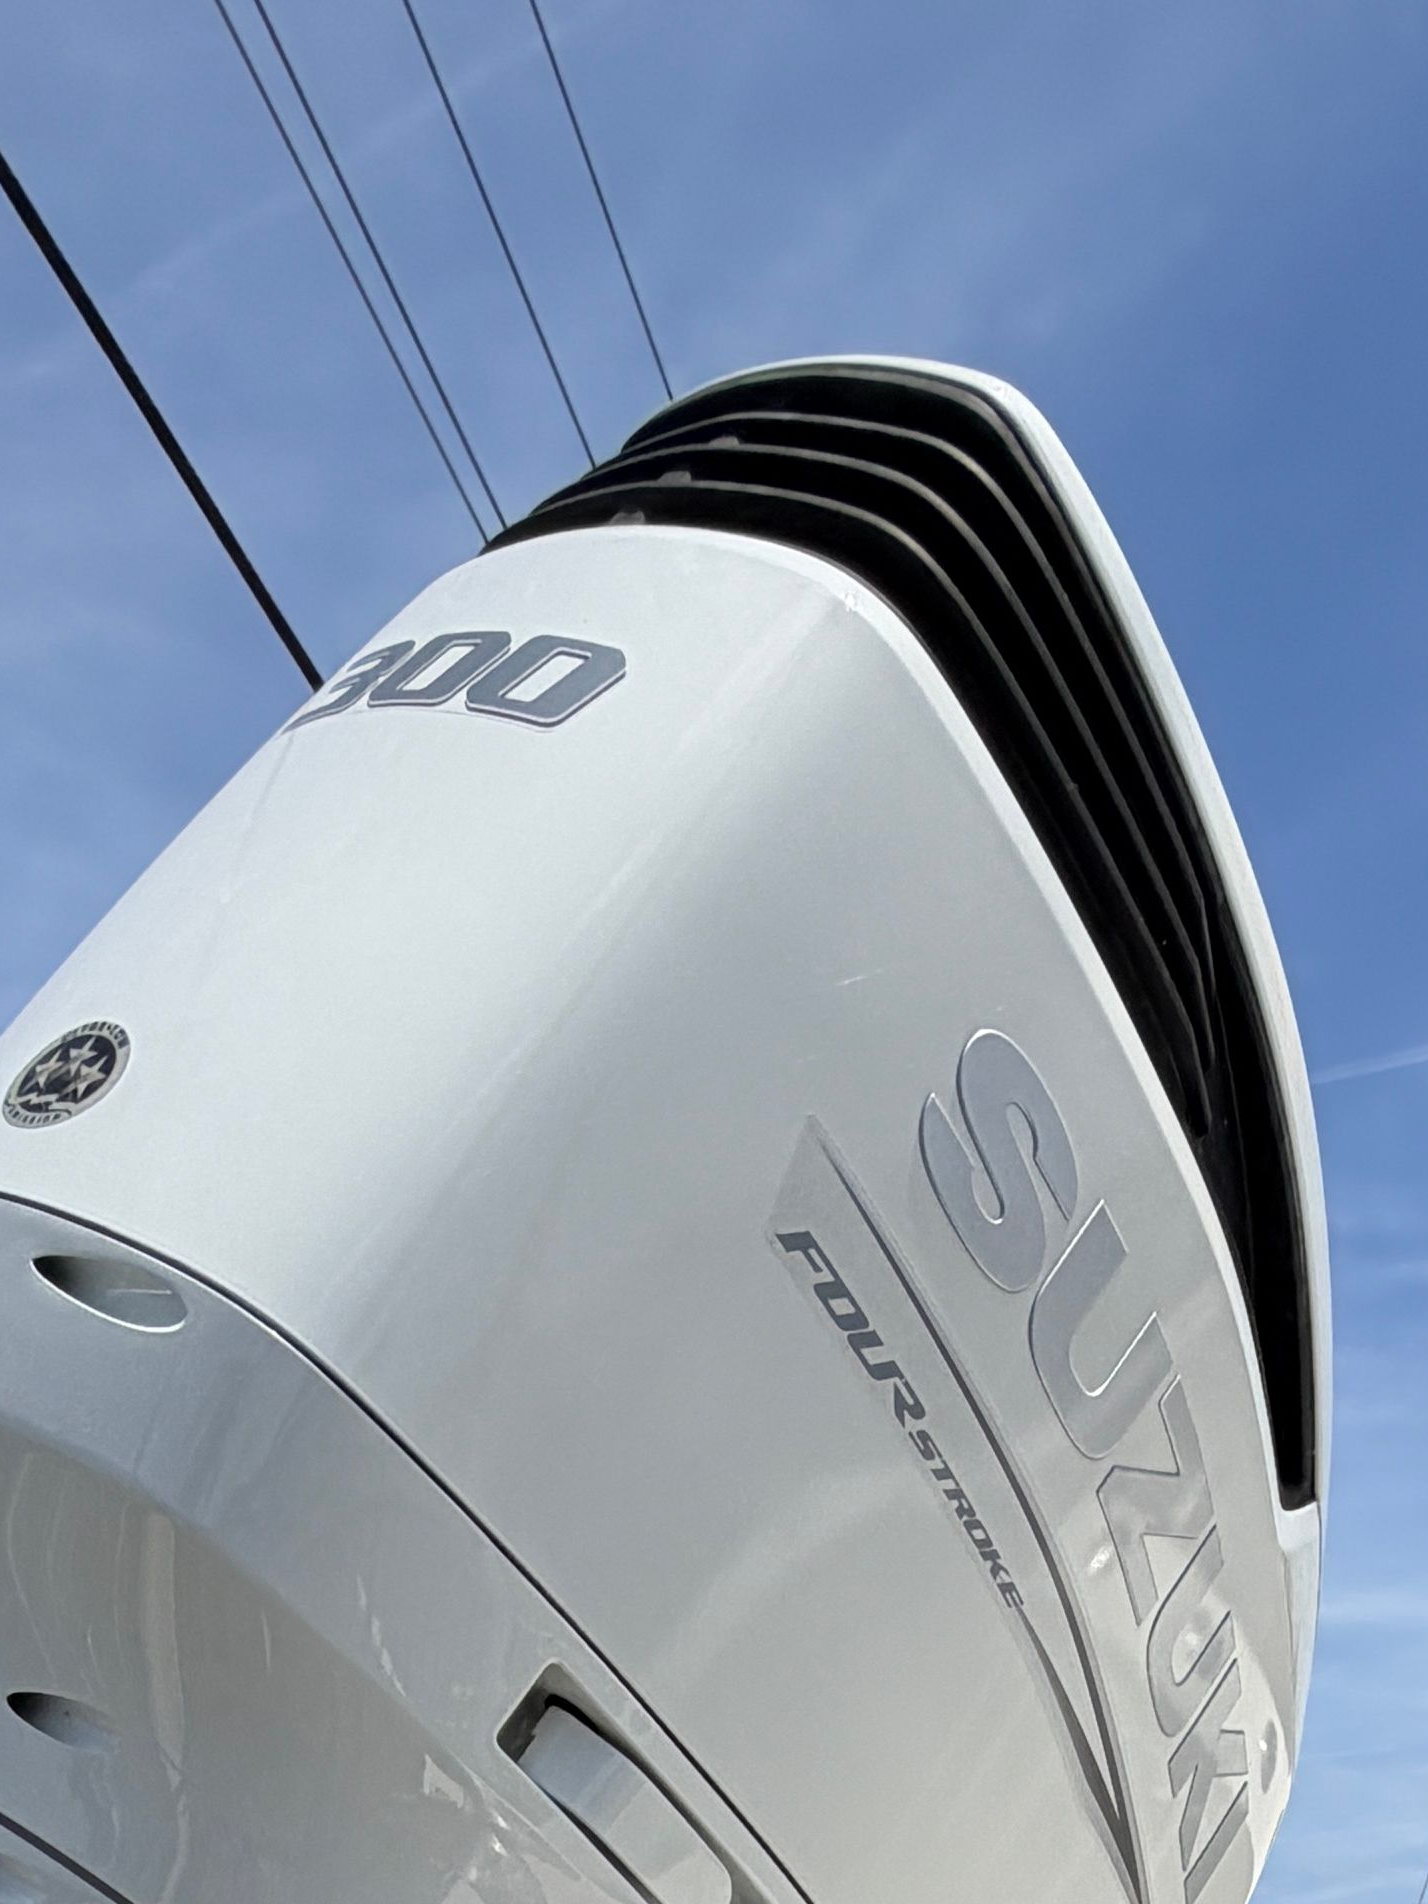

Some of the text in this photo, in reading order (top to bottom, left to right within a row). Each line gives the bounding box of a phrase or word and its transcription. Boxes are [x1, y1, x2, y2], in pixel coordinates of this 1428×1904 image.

[283, 631, 626, 729] 300
[775, 1231, 1024, 1607] FOUR STROKE
